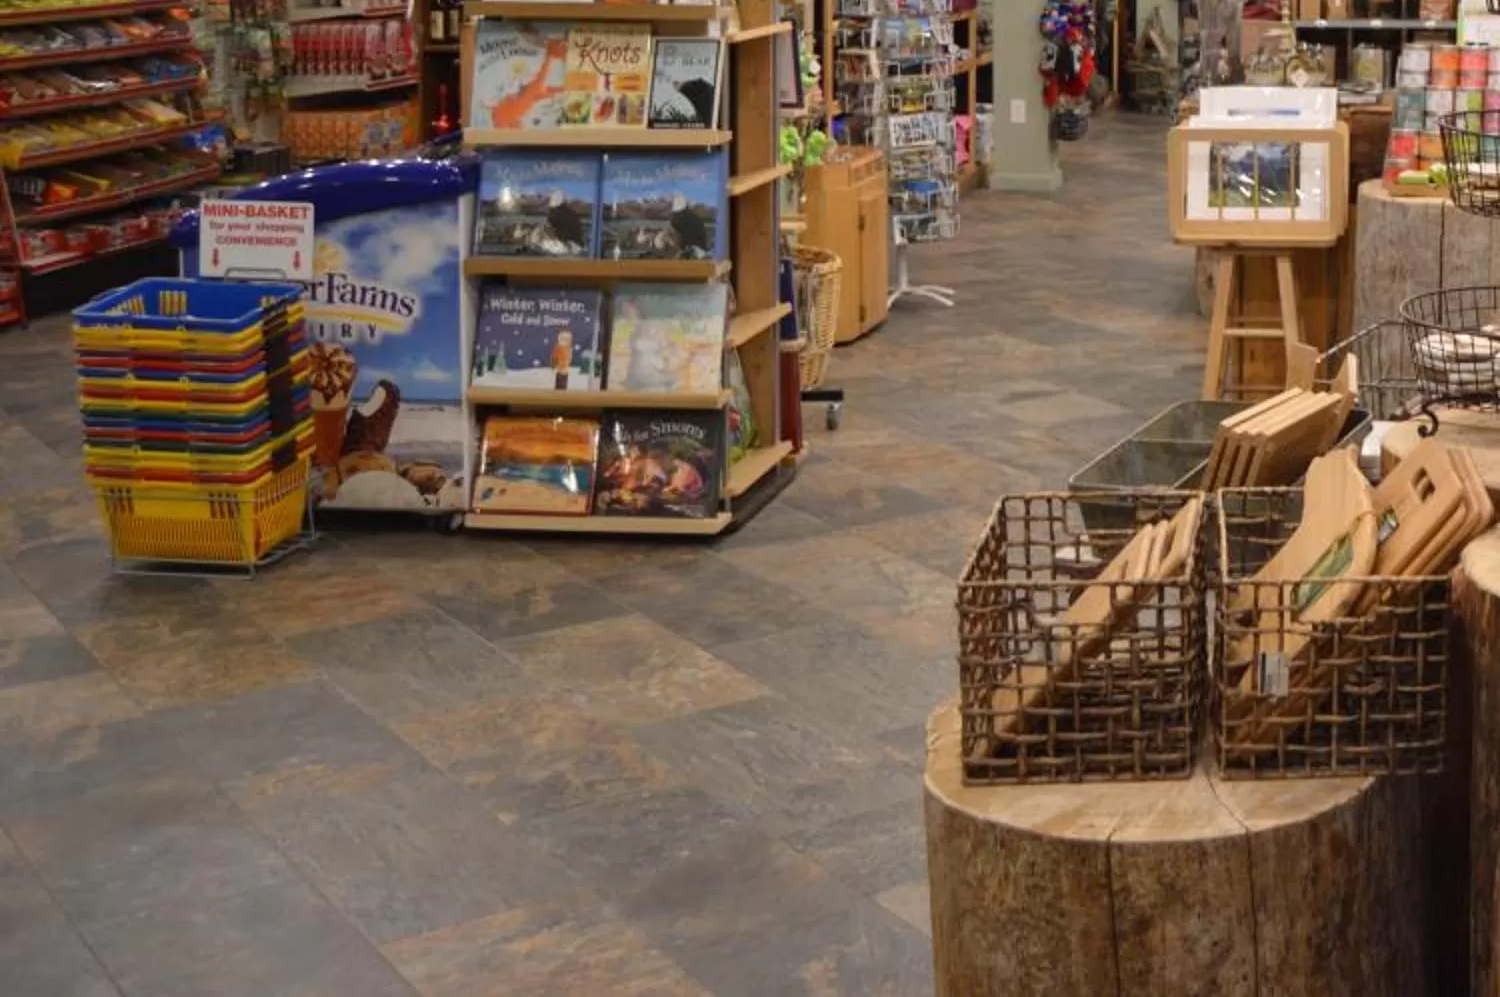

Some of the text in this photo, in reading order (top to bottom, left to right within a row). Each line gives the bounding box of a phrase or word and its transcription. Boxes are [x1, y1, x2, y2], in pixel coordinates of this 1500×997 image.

[574, 36, 642, 71] Knots
[203, 203, 310, 220] MINI-BASKET
[215, 234, 298, 247] CONVENIENCE
